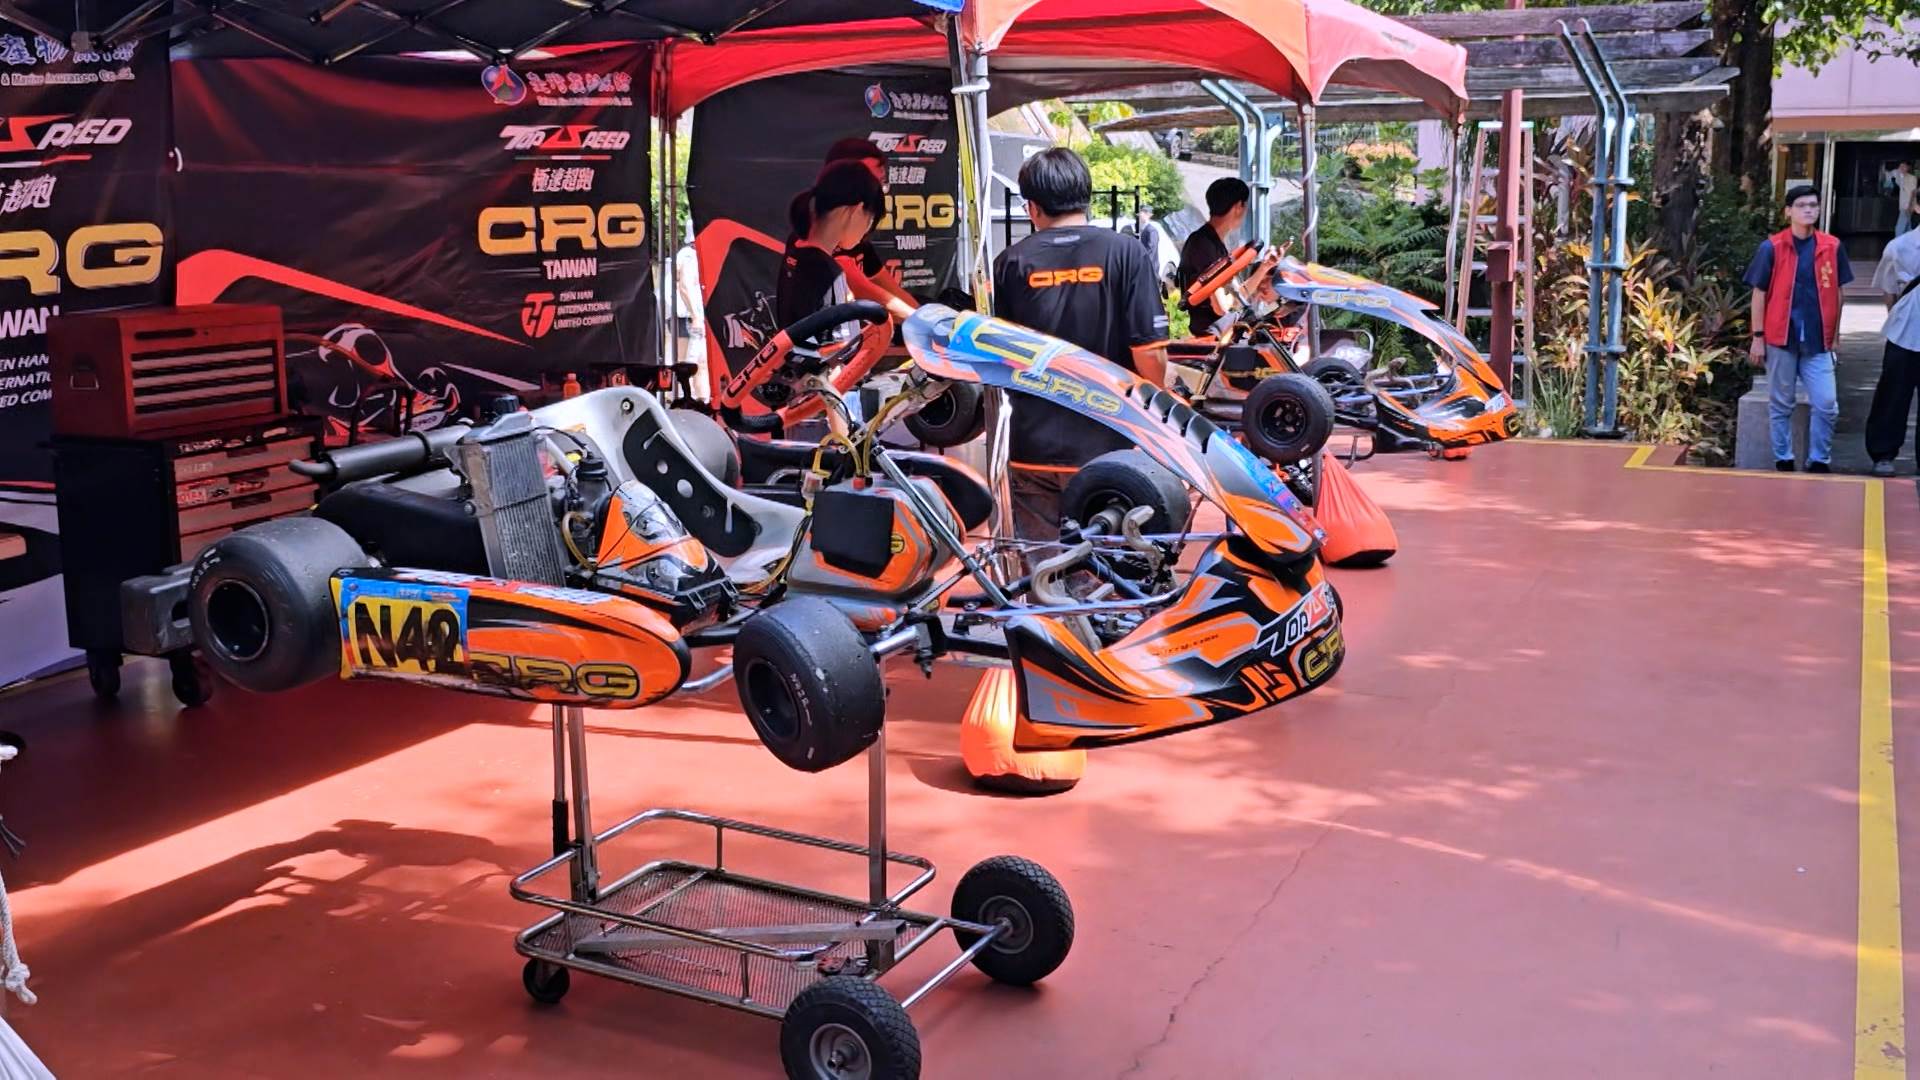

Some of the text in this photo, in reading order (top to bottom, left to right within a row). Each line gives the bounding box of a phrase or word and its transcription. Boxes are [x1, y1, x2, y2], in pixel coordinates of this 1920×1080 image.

[478, 203, 645, 256] CRG
[895, 234, 927, 250] TAIWAN
[543, 257, 597, 280] TAIWAN
[1029, 266, 1104, 289] CRG
[1011, 368, 1122, 415] CRG
